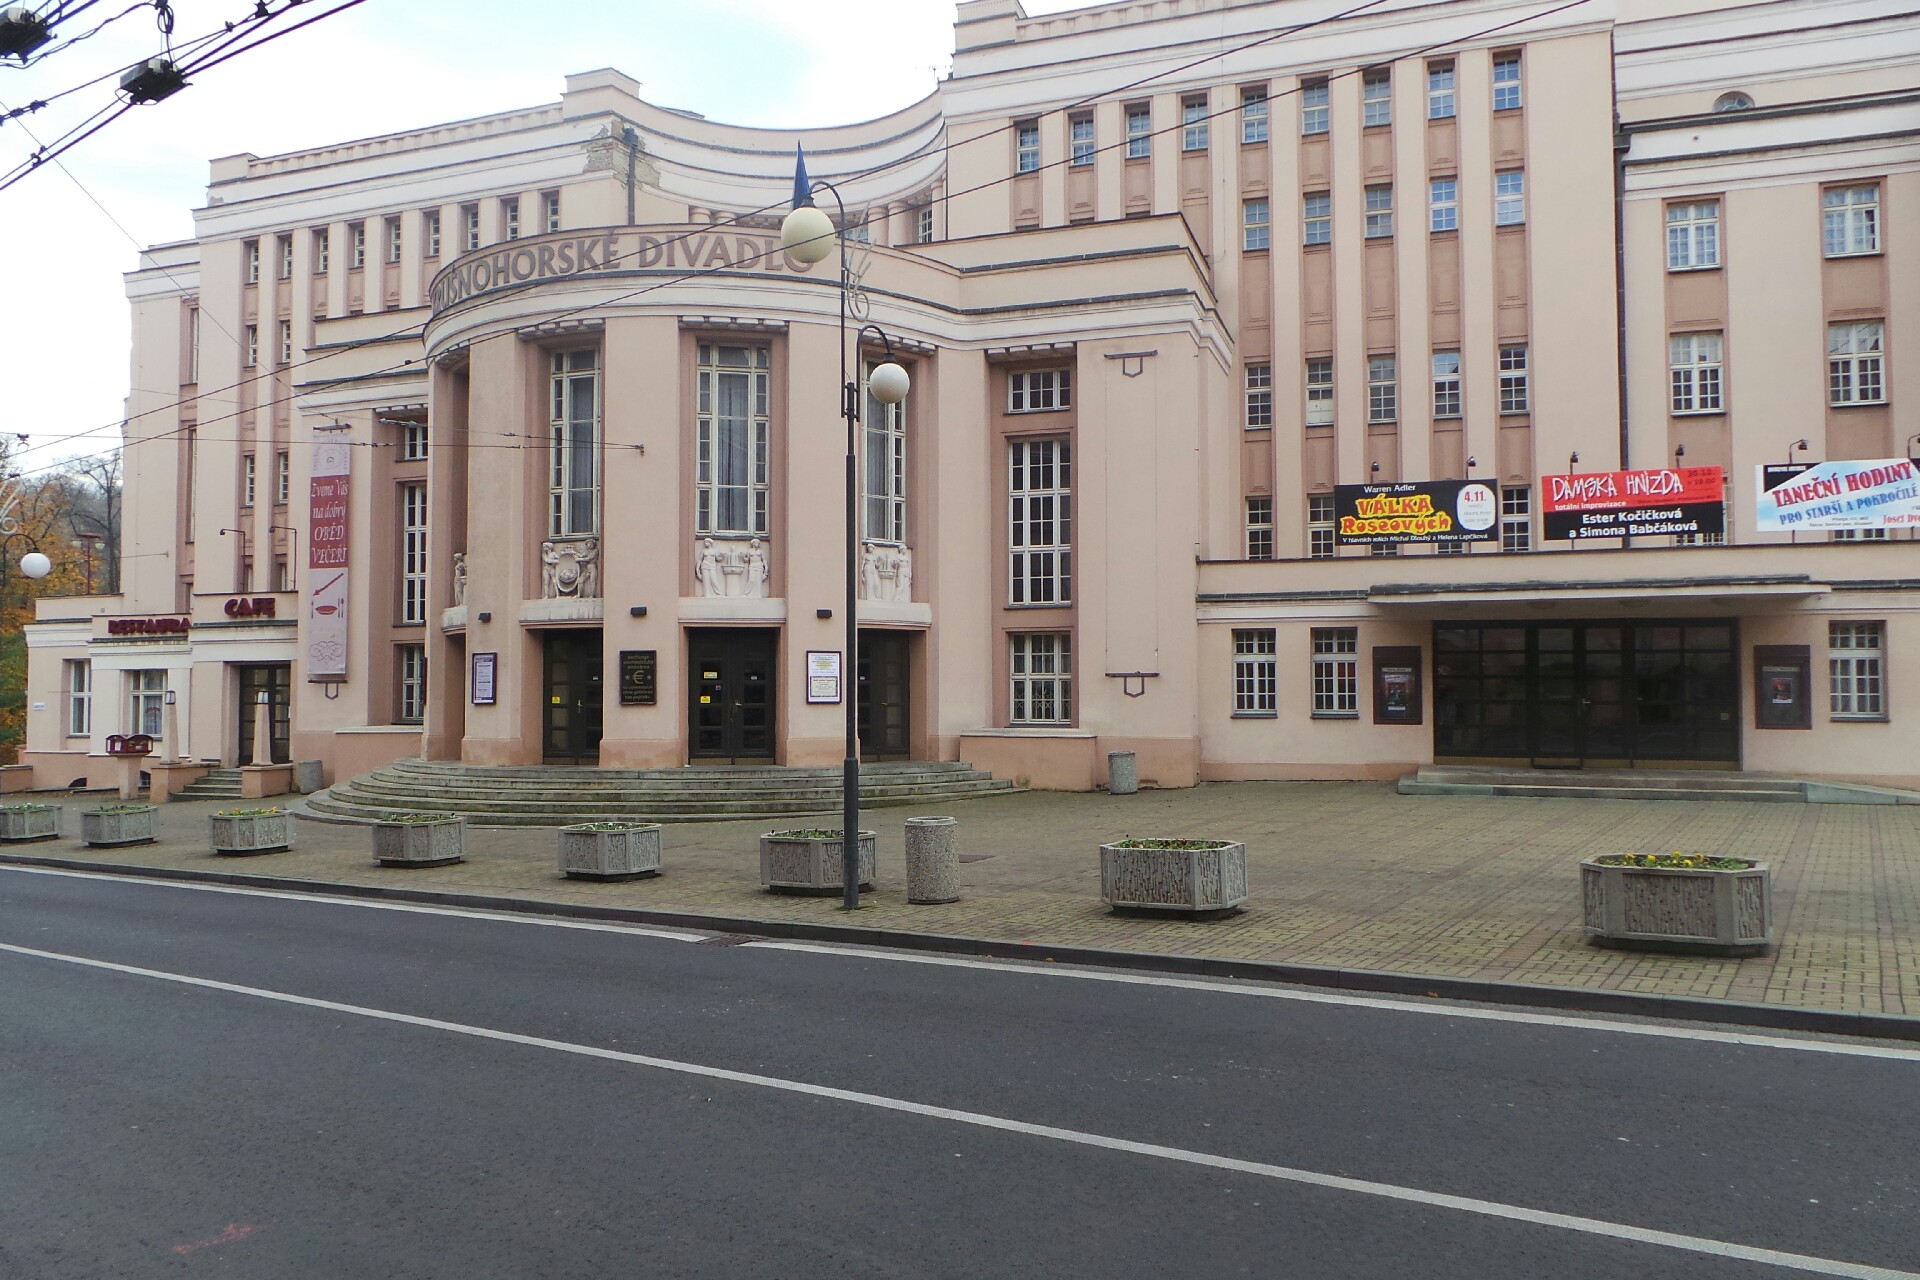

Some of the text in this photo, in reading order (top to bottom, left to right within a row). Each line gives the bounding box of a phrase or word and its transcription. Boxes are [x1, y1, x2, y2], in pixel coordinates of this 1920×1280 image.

[311, 483, 334, 497] Zveme
[1552, 470, 1684, 501] DÁMSKÁ HNÍZDA
[1772, 461, 1913, 507] TANEČNÍ HODINY
[312, 501, 346, 521] na dobrý
[1357, 494, 1433, 516] VÁLKA
[1581, 501, 1627, 510] improvizace
[1779, 483, 1919, 525] PRO STARŠÍ A POKROČILÉ
[1341, 513, 1451, 534] Roseových
[1582, 508, 1683, 524] Ester Kočičková
[314, 522, 345, 541] OBĚD
[1569, 520, 1698, 538] a Simona Babčáková
